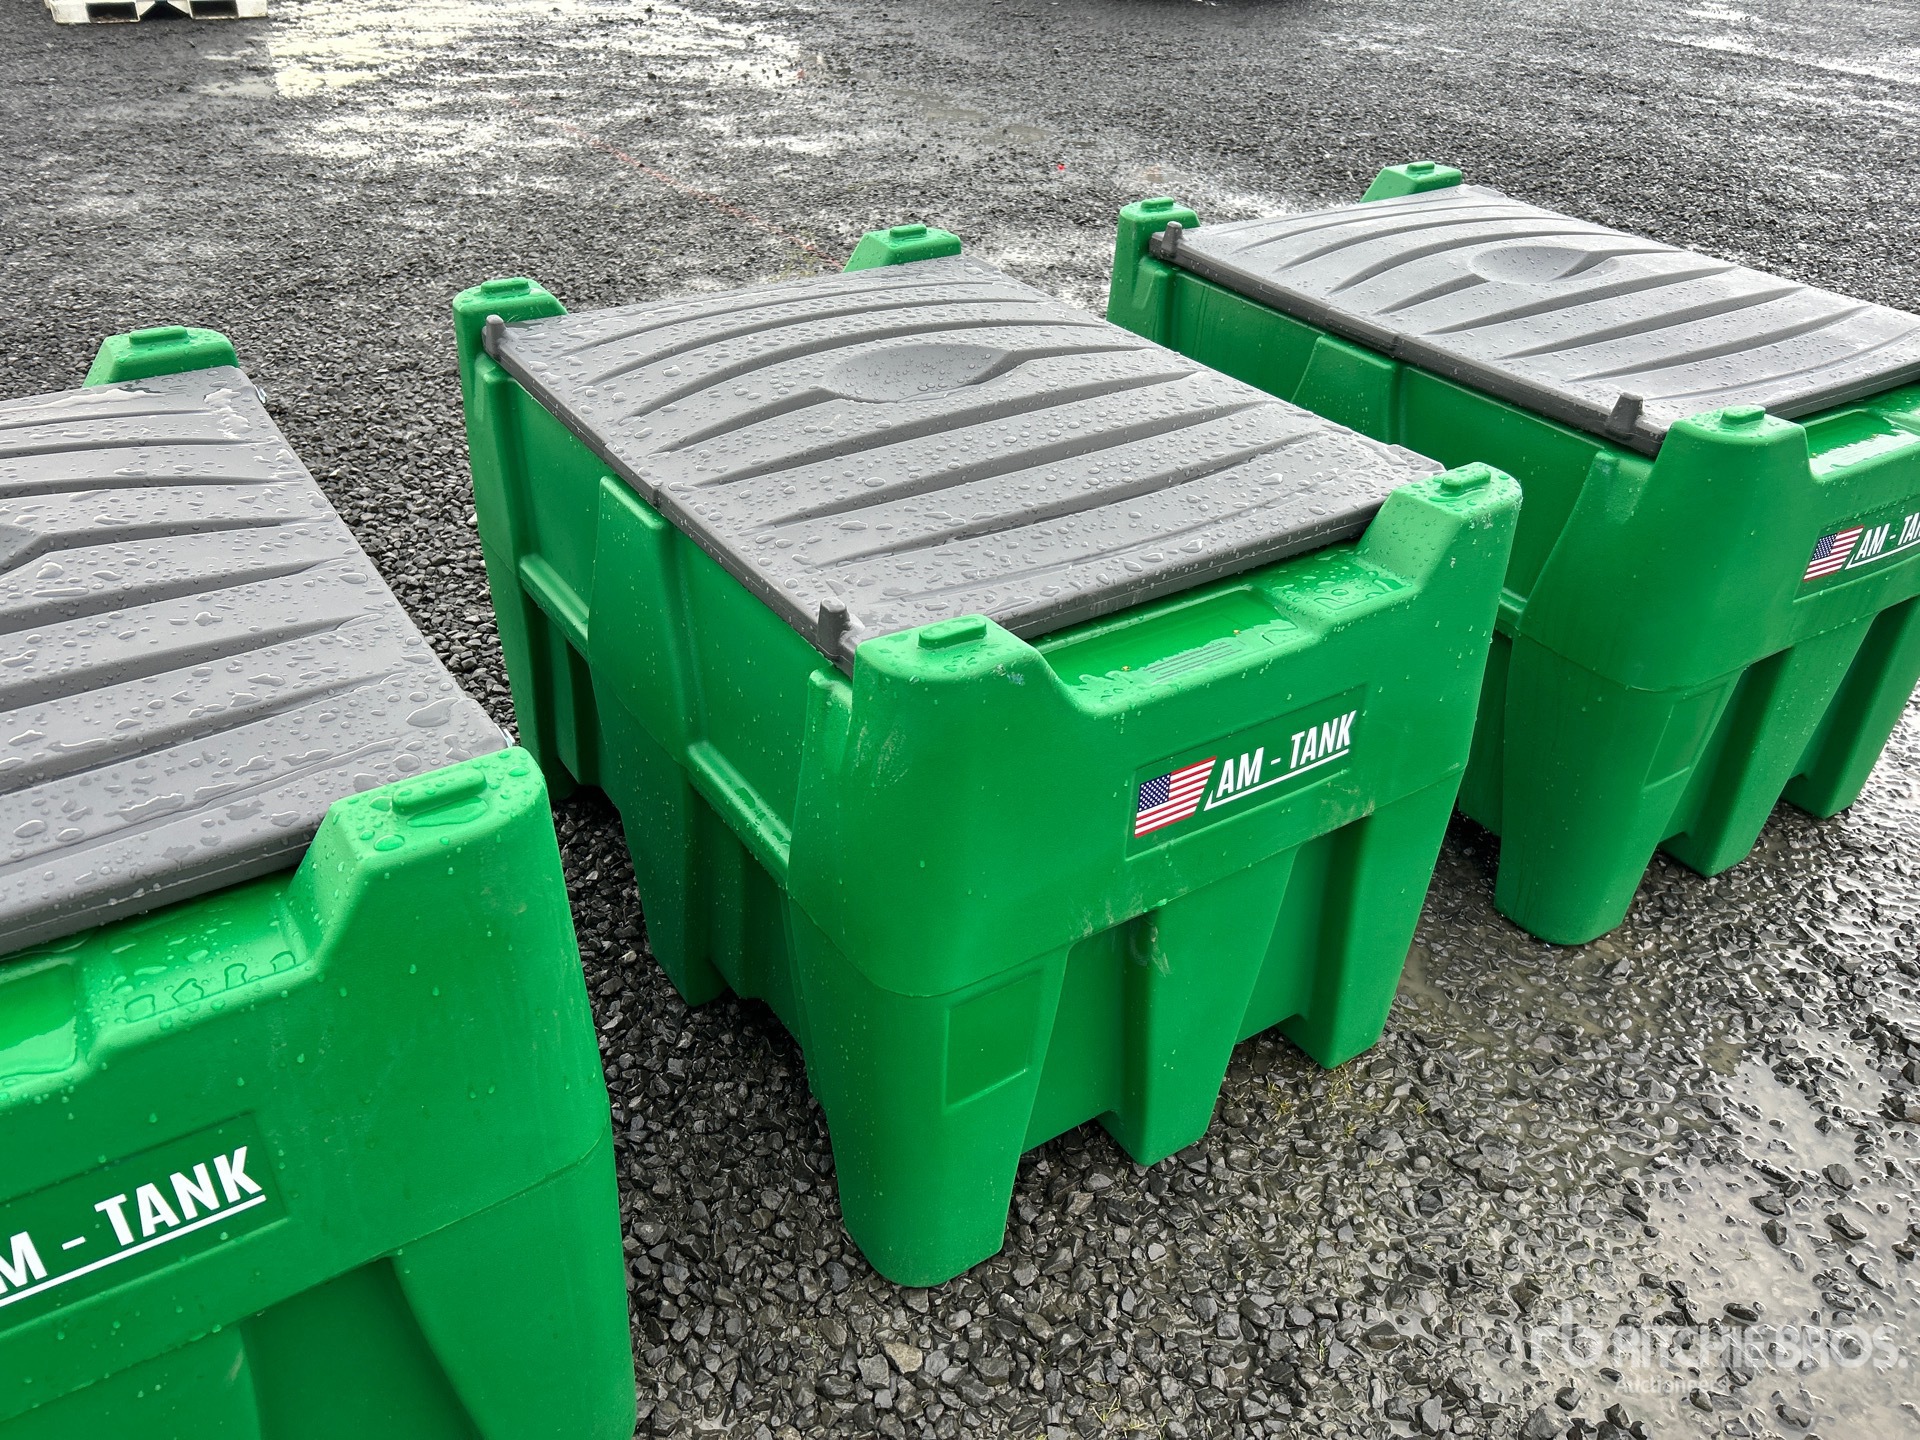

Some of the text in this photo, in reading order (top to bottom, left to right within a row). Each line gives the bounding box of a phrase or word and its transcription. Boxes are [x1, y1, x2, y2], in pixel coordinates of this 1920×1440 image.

[1855, 523, 1890, 560] AM
[1216, 747, 1264, 798] AM
[1289, 710, 1357, 769] TANK
[94, 1145, 262, 1246] TANK
